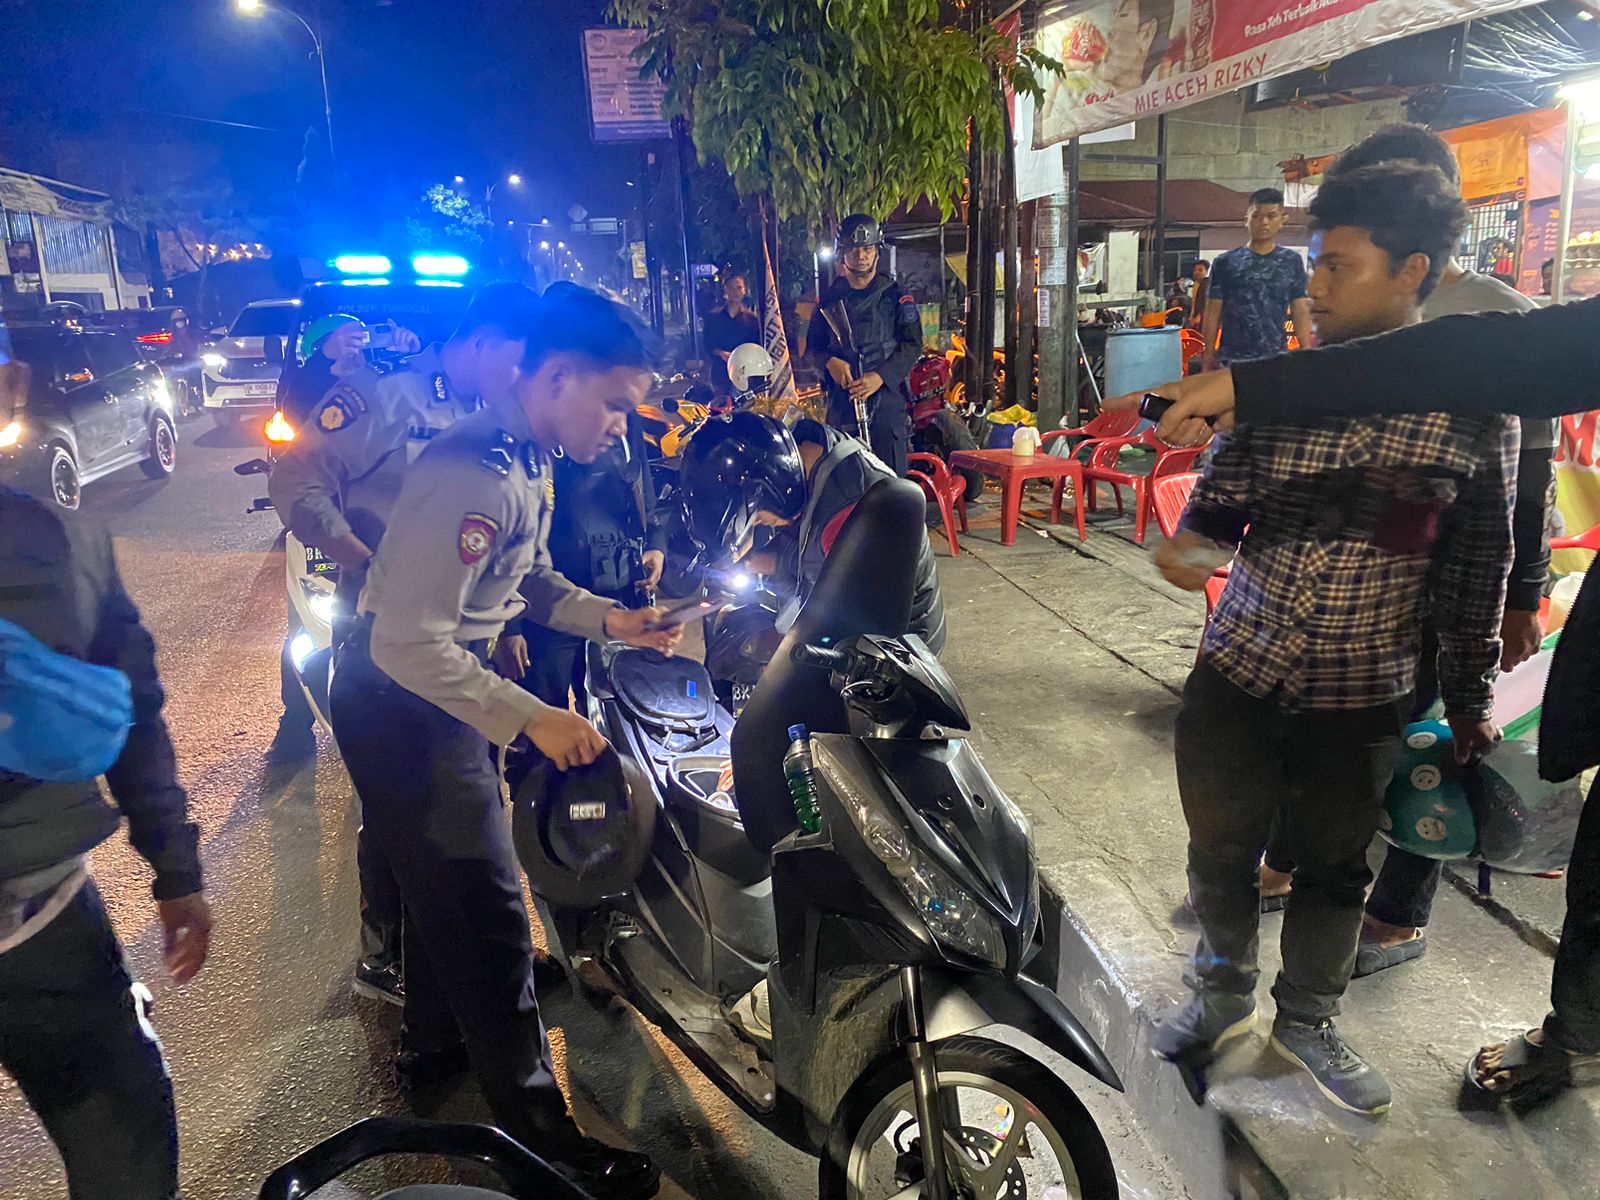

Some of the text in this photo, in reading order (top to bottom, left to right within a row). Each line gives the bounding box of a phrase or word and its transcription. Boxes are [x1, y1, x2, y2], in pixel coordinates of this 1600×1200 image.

[1135, 89, 1159, 114] MIE
[1165, 74, 1208, 104] ACEH
[1214, 52, 1267, 88] RIZKY
